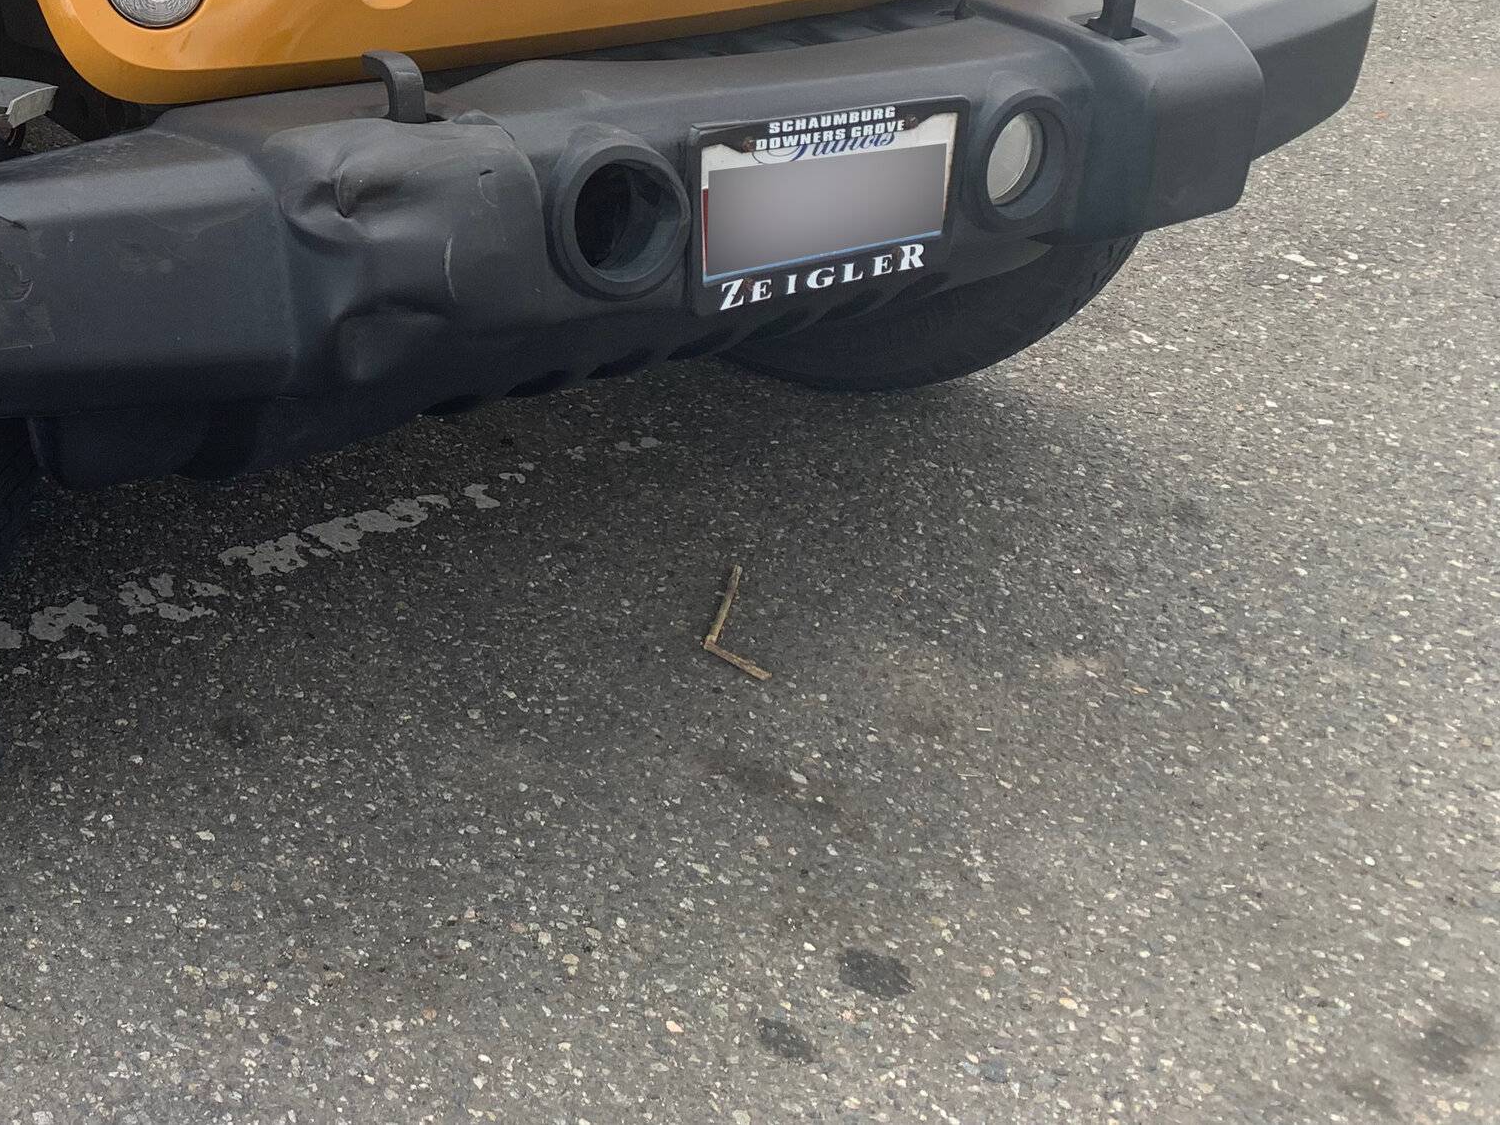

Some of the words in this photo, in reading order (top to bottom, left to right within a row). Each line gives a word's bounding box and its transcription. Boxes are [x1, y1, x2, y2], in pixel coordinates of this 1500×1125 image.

[755, 128, 846, 151] DOWNERS
[851, 119, 906, 139] GROVE
[768, 105, 896, 134] SCHAUMBURG
[719, 243, 925, 311] ZEIGLER
